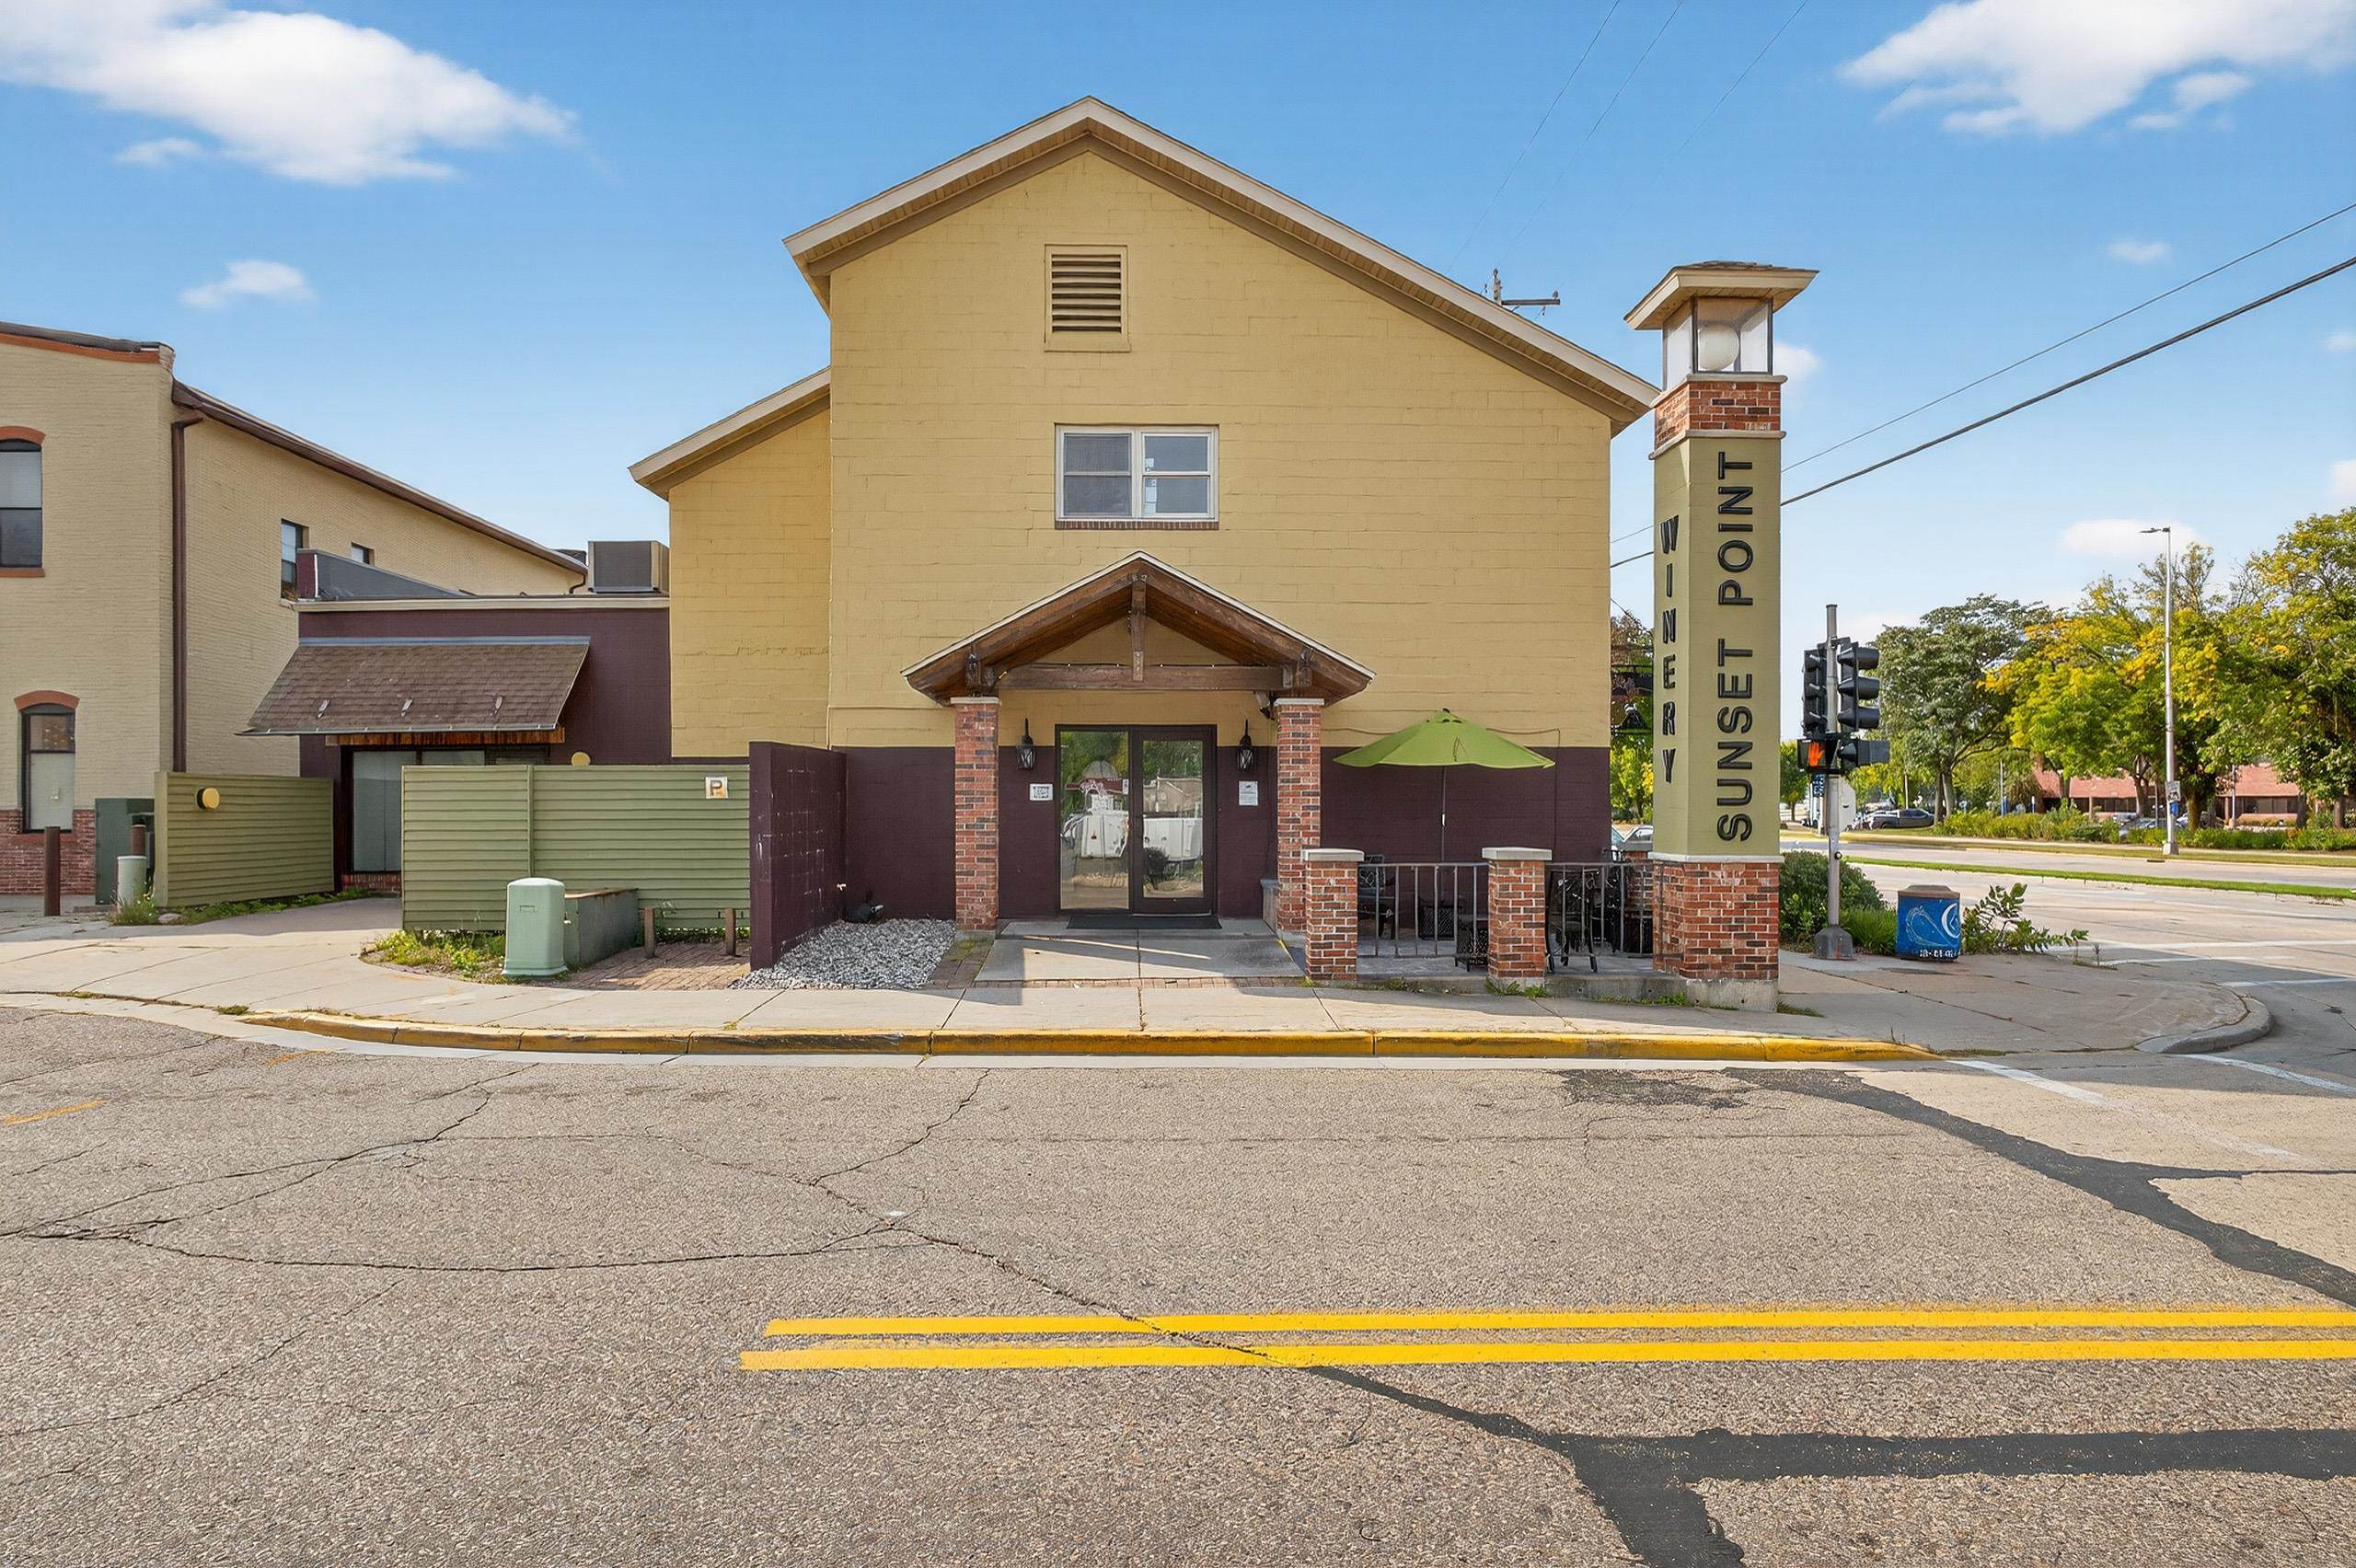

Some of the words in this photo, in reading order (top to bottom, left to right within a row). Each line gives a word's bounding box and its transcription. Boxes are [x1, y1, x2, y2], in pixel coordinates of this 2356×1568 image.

[1716, 451, 1754, 606] POINT
[1659, 513, 1680, 785] WINERY
[1716, 638, 1754, 842] SUNSET
